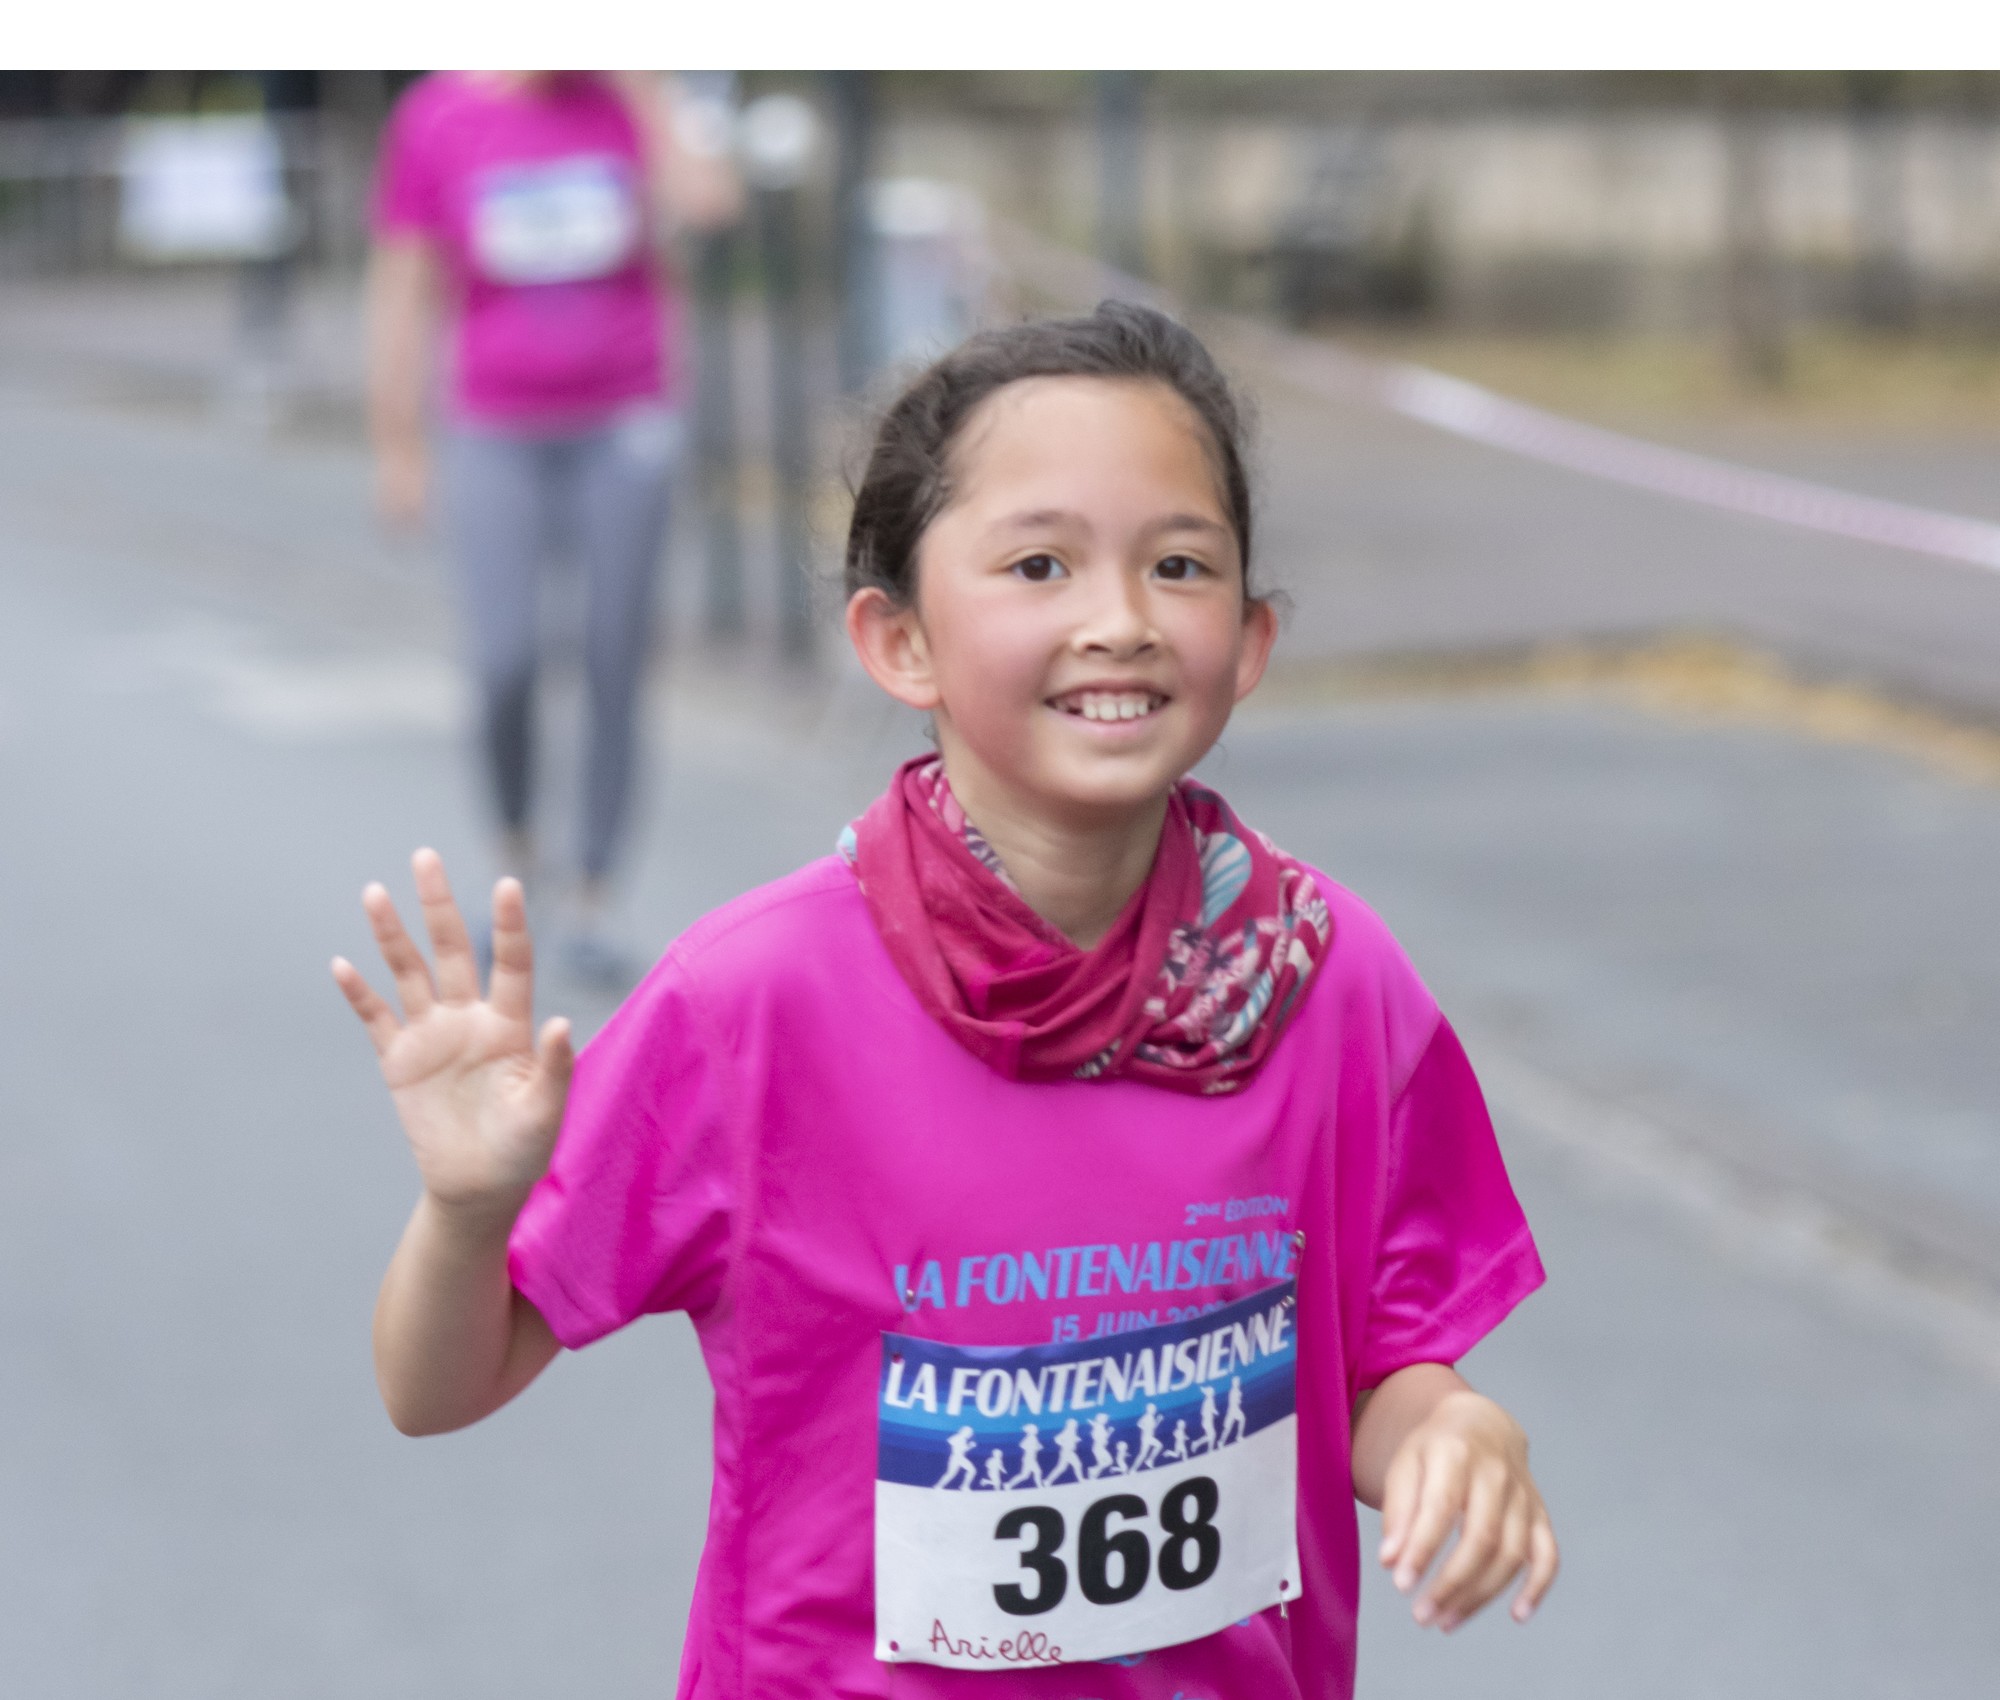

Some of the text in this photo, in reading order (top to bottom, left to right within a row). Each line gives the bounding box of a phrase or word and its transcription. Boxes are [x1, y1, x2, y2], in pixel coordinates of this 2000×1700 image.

[894, 1230, 1299, 1313] LA FONTENAISIENNE
[884, 1302, 1291, 1416] LA FONTENAISIENNE
[1052, 1314, 1080, 1344] 15
[1088, 1309, 1159, 1340] JUIN
[992, 1475, 1221, 1616] 368
[928, 1618, 1064, 1664] Arielle
